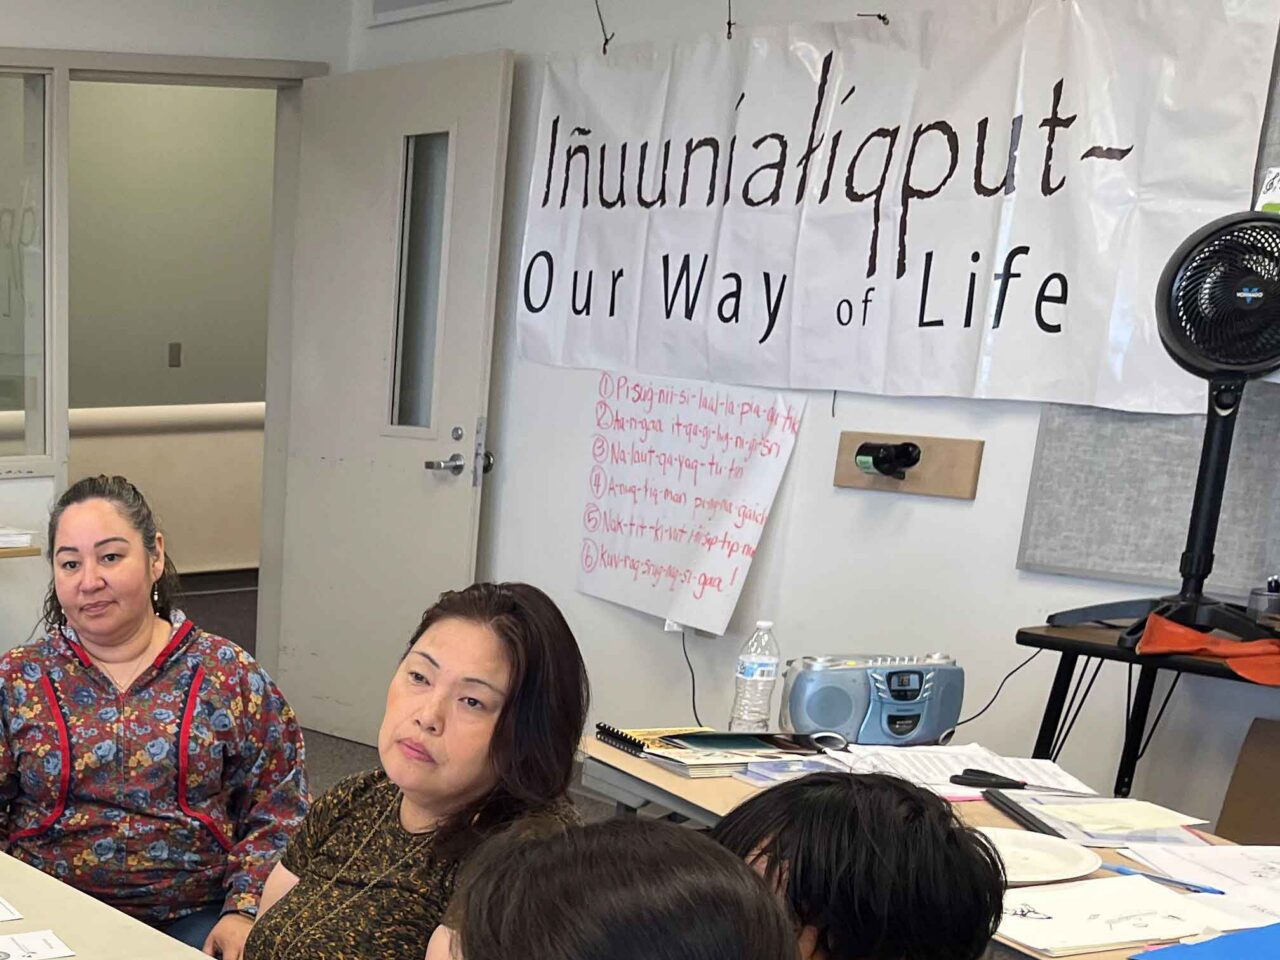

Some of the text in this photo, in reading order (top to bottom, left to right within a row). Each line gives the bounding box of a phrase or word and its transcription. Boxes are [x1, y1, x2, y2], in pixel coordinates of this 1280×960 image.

[524, 246, 1068, 344] Our Way of Life
